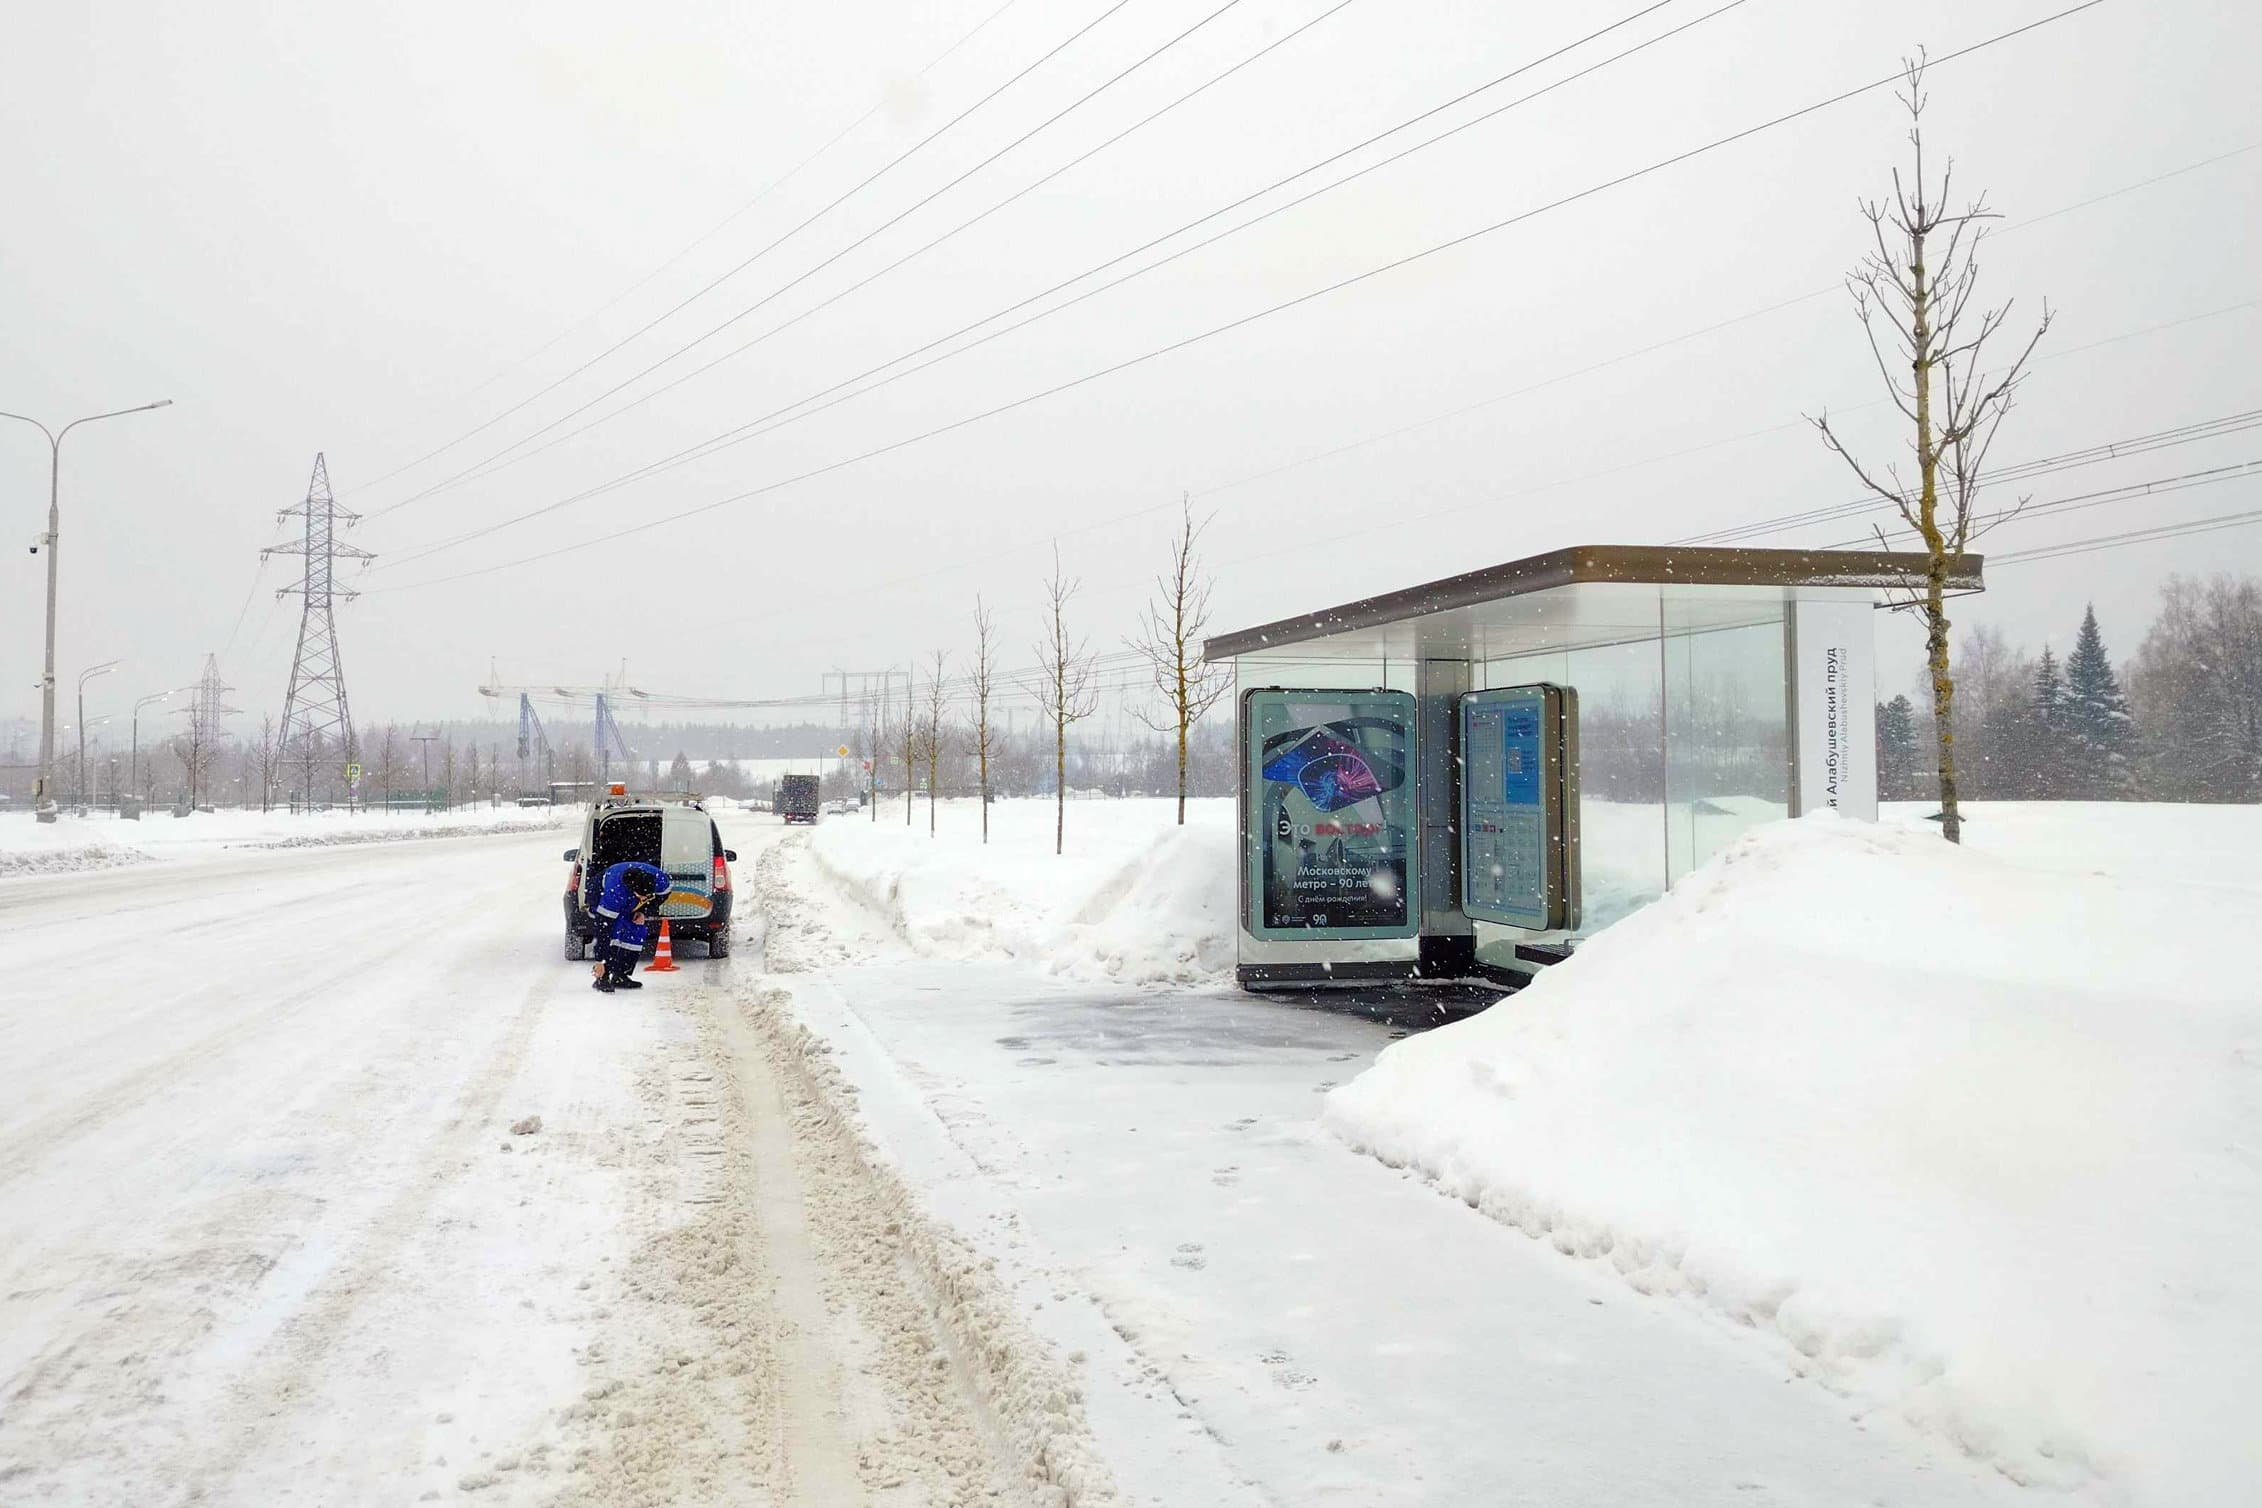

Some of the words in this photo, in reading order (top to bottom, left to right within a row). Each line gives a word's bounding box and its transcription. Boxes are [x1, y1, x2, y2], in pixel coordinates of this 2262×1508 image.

[1827, 647, 1839, 683] пруд
[1839, 647, 1848, 671] Prud
[1825, 687, 1840, 795] Алабушевский
[1279, 820, 1311, 836] Это
[1297, 866, 1372, 877] Московскому
[1293, 881, 1328, 891] метро
[1339, 878, 1353, 889] 90
[1297, 895, 1304, 904] С
[1305, 895, 1325, 904] днём
